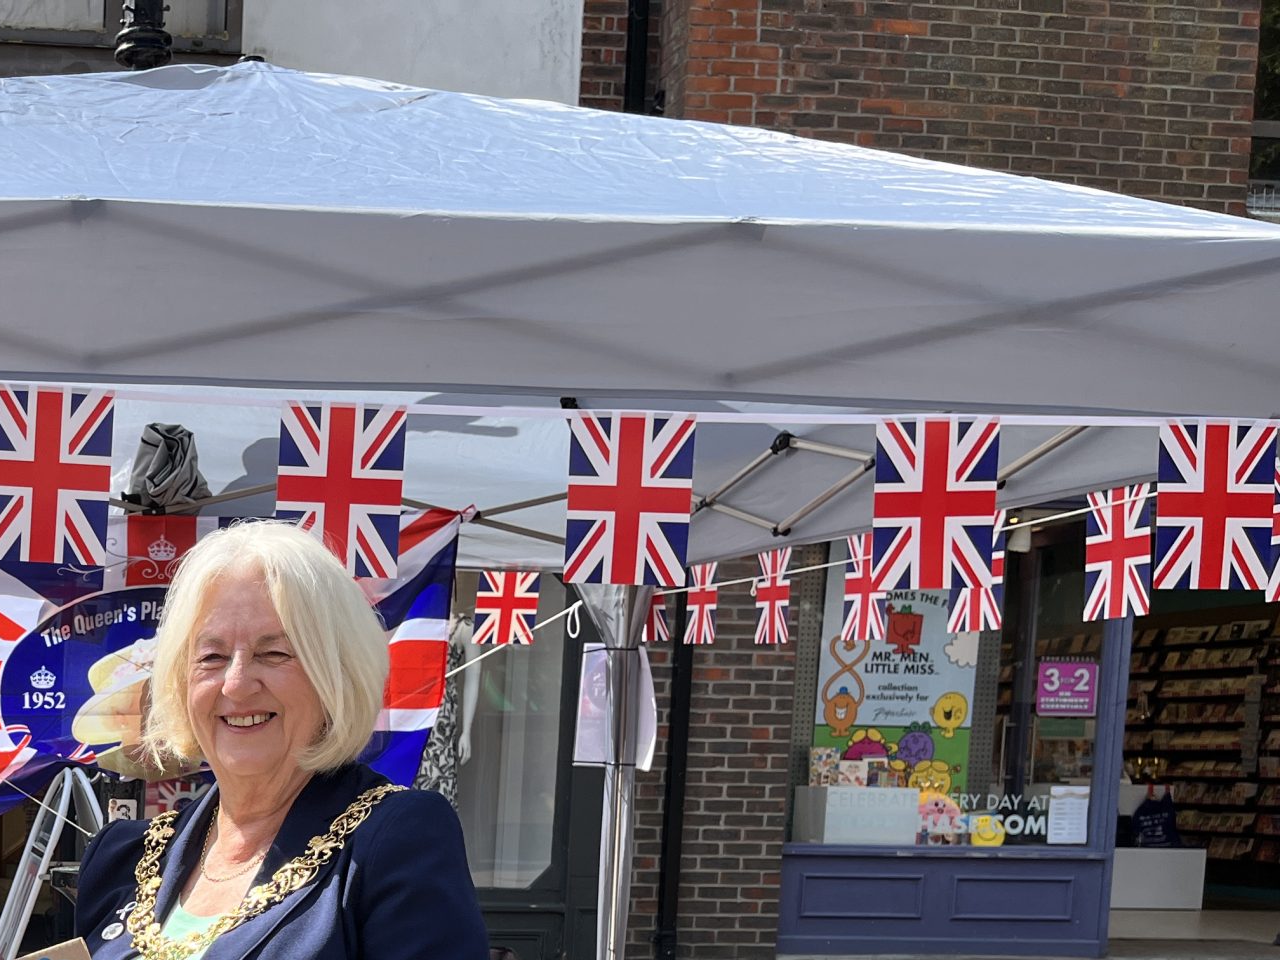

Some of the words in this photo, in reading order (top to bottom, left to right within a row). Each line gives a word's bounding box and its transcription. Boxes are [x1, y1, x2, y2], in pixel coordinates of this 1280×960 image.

[885, 591, 916, 601] OMES
[920, 593, 939, 606] THE
[40, 624, 72, 648] The
[74, 603, 137, 635] Queen's
[140, 601, 163, 621] Pla
[871, 651, 896, 662] MR.
[864, 663, 899, 674] LITTLE
[903, 664, 935, 675] MISS
[1043, 667, 1060, 692] 3
[1074, 667, 1090, 692] 2
[878, 683, 918, 692] collection
[22, 691, 66, 709] 1952
[865, 693, 913, 703] exclusively
[916, 693, 929, 701] for
[986, 794, 1023, 811] DAY
[1027, 794, 1049, 811] AT
